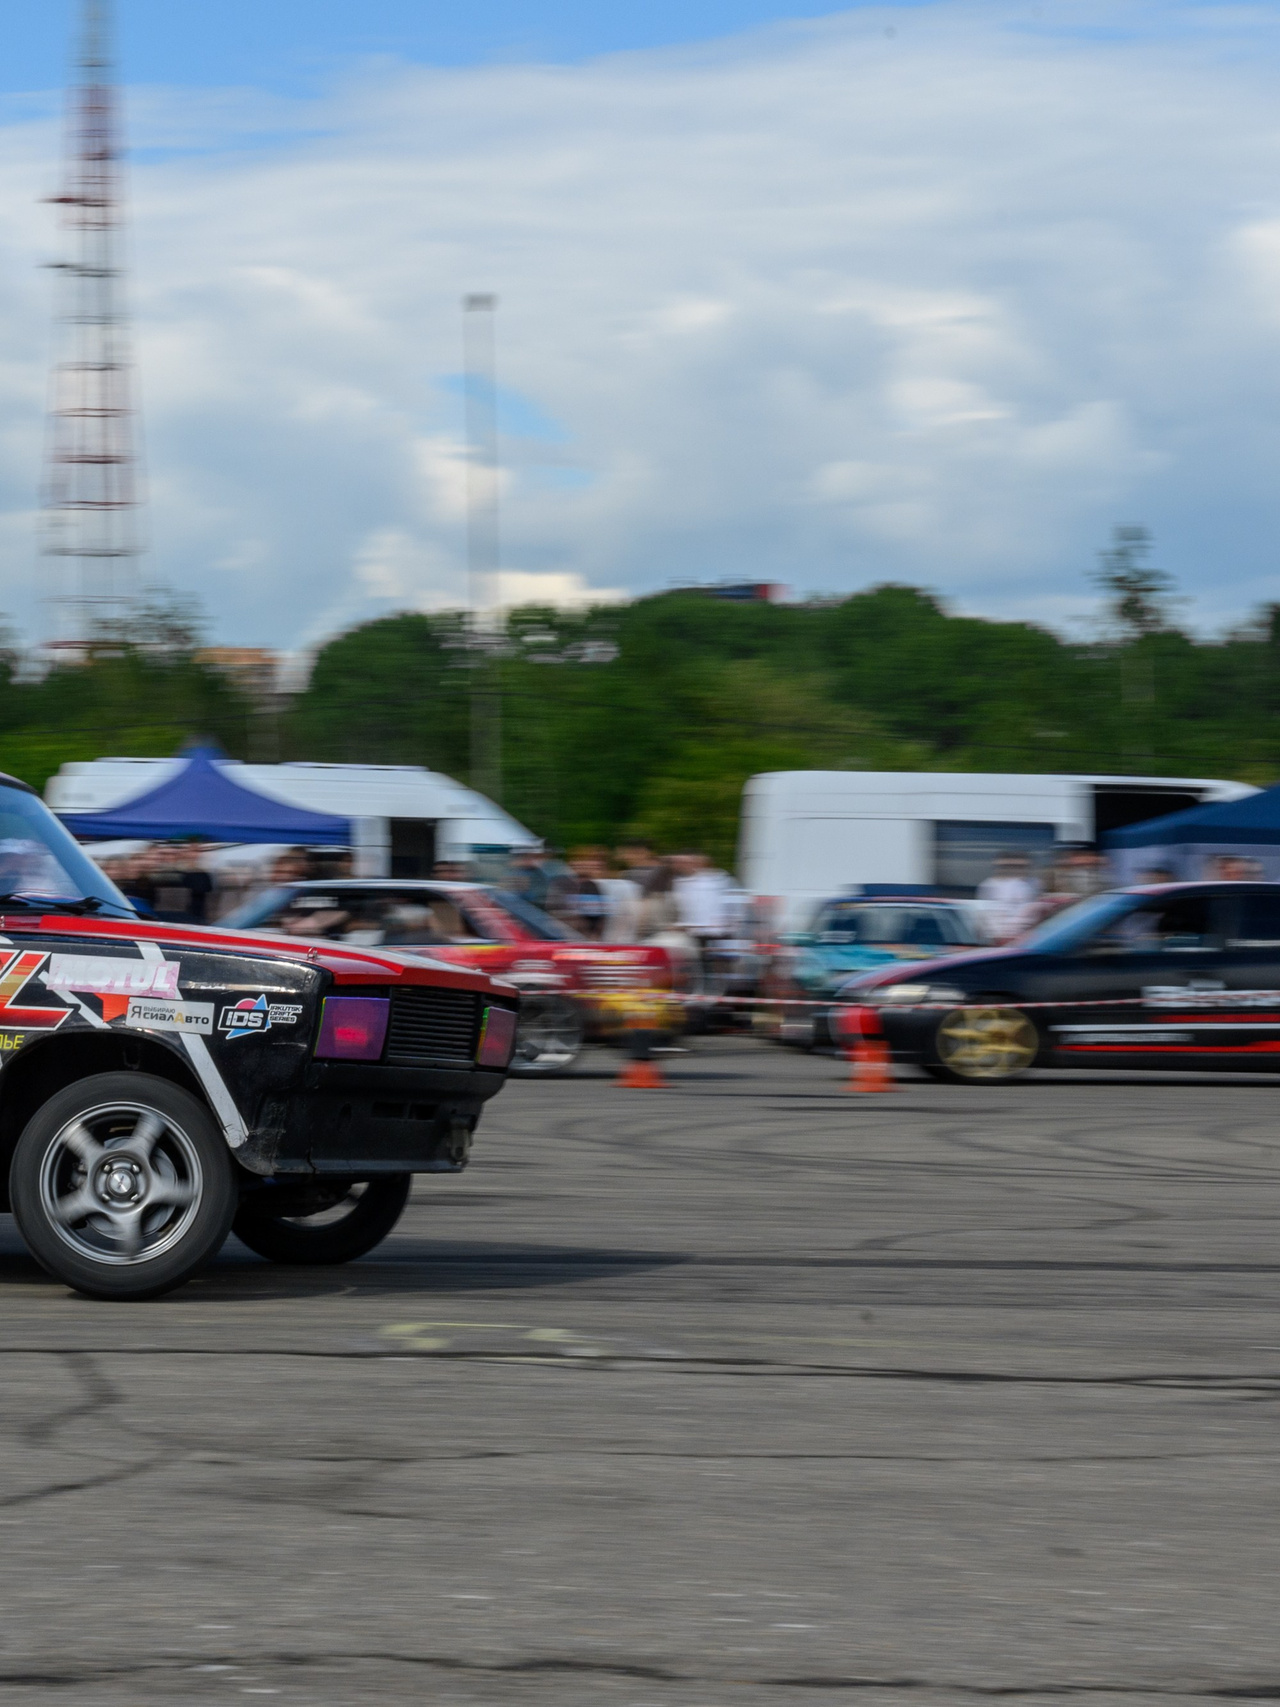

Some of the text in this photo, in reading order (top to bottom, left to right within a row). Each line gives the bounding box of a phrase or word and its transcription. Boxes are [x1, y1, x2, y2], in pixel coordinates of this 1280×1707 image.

[53, 960, 172, 993] MOTUL
[130, 1005, 142, 1019] Я
[143, 1006, 176, 1014] ВЫБИРАЮ
[225, 1011, 264, 1027] IDS
